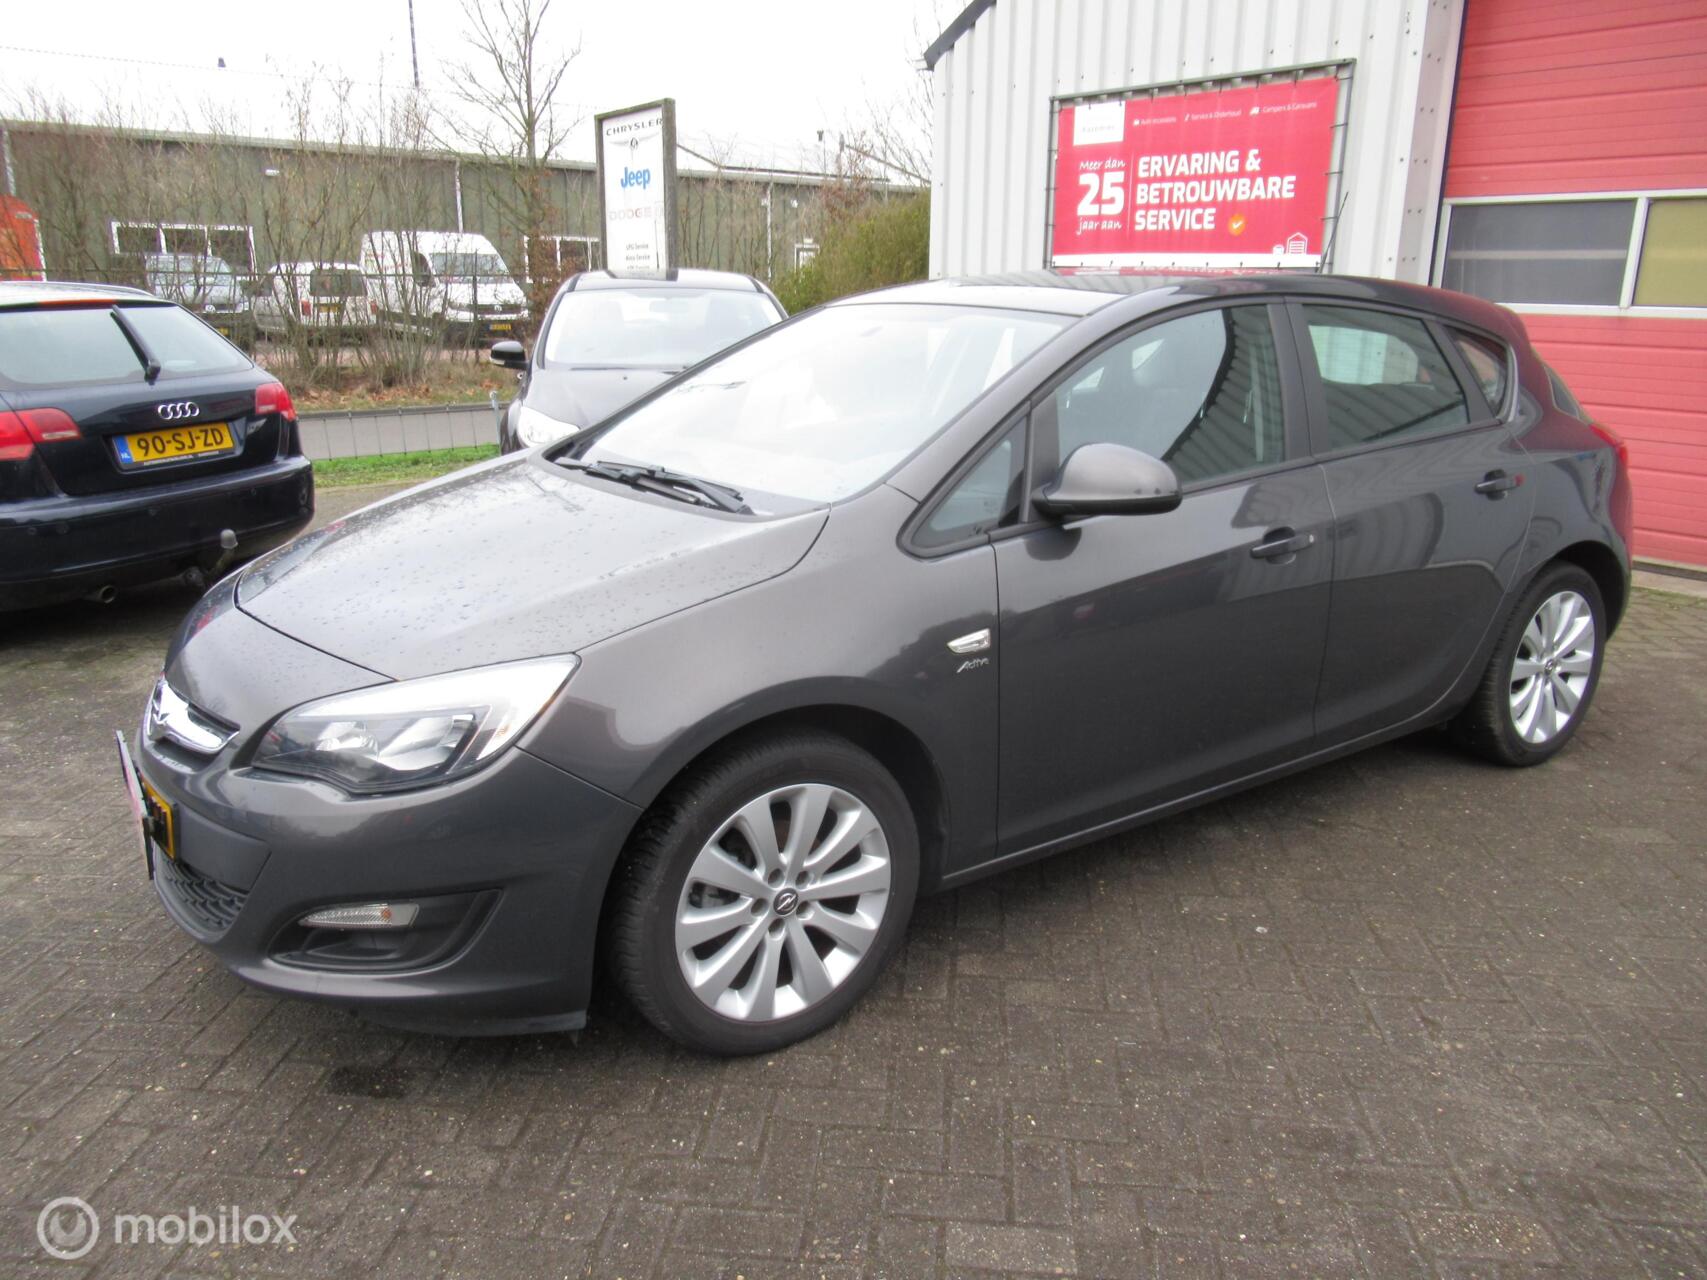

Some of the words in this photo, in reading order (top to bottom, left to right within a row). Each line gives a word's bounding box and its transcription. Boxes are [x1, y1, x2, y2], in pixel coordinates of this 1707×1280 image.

[606, 117, 663, 136] CHRYSLER
[1079, 160, 1103, 170] Meer
[1104, 156, 1126, 169] dan
[1138, 150, 1240, 178] ERVARING
[1245, 148, 1262, 172] &
[620, 167, 651, 190] Jeep
[1136, 175, 1297, 205] BETROUWBARE
[1077, 171, 1125, 216] 25
[1076, 217, 1099, 235] jaar
[1101, 219, 1122, 230] aan
[1134, 208, 1217, 231] SERVICE
[137, 427, 224, 457] 90-SJ-ZD
